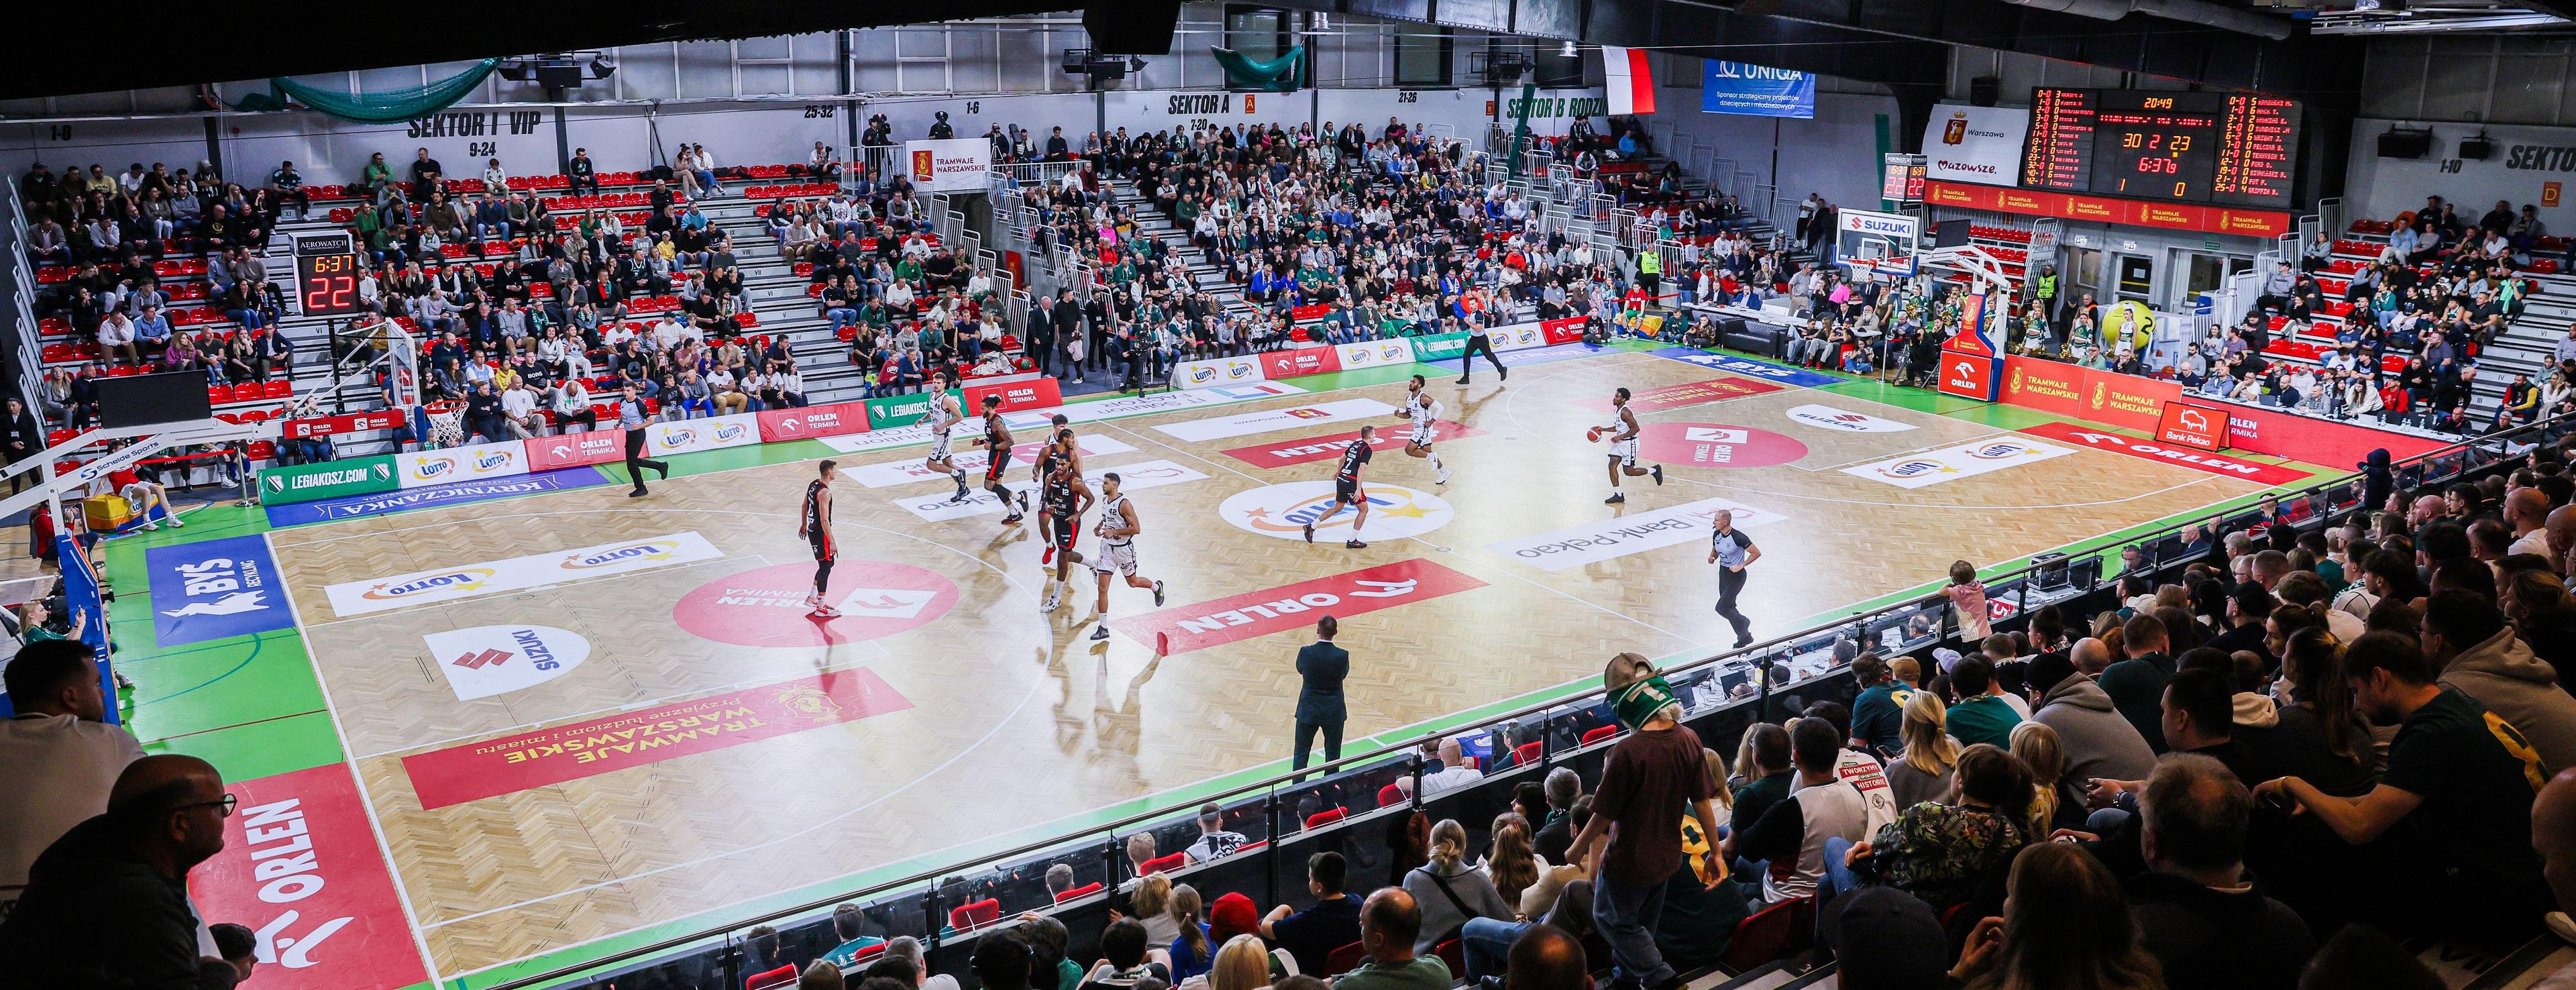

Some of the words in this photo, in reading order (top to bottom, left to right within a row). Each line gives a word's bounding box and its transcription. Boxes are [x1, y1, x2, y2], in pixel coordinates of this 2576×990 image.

[1745, 64, 1803, 80] UNIQA
[1168, 95, 1218, 114] SEKTOR
[1221, 95, 1229, 113] A
[1246, 99, 1254, 109] A
[1399, 92, 1417, 103] 21-26
[2144, 98, 2172, 108] 20:49
[804, 105, 833, 118] 25-32
[967, 101, 979, 114] 1-6
[1507, 98, 1552, 118] SETOR
[1556, 98, 1564, 117] B
[408, 112, 477, 138] SEKTOR
[491, 112, 498, 135] I
[510, 111, 541, 134] VIP
[1191, 119, 1208, 131] 7-20
[1968, 129, 2004, 138] Warszawa
[2123, 133, 2142, 148] 30
[2149, 134, 2160, 149] 2
[2170, 136, 2190, 150] 23
[470, 142, 496, 156] 9-24
[2506, 145, 2576, 172] SEKTO
[936, 164, 985, 172] WARSZAWSKIE
[1891, 166, 1908, 175] 6:37
[1913, 167, 1926, 176] 6:37
[2440, 159, 2463, 173] 1-10
[1886, 176, 1907, 195] 22
[1908, 178, 1925, 195] 22
[2121, 178, 2125, 191] 1
[2174, 182, 2186, 197] 0
[2544, 188, 2557, 201] D
[2152, 215, 2187, 223] WARSZAWSKIE
[1864, 220, 1911, 233] SUZUKI
[301, 240, 347, 248] AEROWATCH
[315, 256, 352, 272] 6:37
[309, 276, 353, 308] 22
[1492, 336, 1505, 345] LOTTO
[1520, 332, 1534, 343] LOTTO
[1428, 339, 1465, 352] LEGIAKOSZ.COM
[1295, 355, 1317, 363] ORLEN
[1352, 352, 1366, 361] LOTTO
[1384, 349, 1399, 358] LOTTO
[1232, 366, 1248, 376] LOTTO
[1297, 361, 1320, 369] TERMIKA
[527, 371, 543, 379] BORG
[1195, 370, 1212, 380] LOTTO
[1951, 379, 1976, 390] ORLEN
[2028, 376, 2068, 390] TRAMWAJE
[1008, 388, 1033, 396] ORLEN
[1010, 395, 1036, 403] TERMIKA
[2027, 384, 2079, 400] WARSZAWSKIE
[2111, 392, 2155, 406] TRAMWAJE
[1097, 402, 1181, 414] Solution
[2110, 400, 2163, 417] WARSZAWSKI
[807, 413, 837, 422] ORLEN
[808, 420, 840, 429] TERMIKA
[1796, 413, 1868, 430] SUZUKI
[2229, 417, 2257, 429] RLEN
[667, 432, 690, 445] LOTTO
[718, 426, 739, 439] LOTTO
[2166, 431, 2185, 441] Bank
[2187, 434, 2210, 446] Pekao
[2231, 428, 2258, 439] RMIKA
[580, 438, 612, 448] ORLEN
[97, 451, 130, 472] Schelde
[130, 439, 159, 456] Sports
[581, 446, 616, 456] TERMIKA
[1693, 444, 1711, 462] TERMIKA
[1713, 445, 1733, 463] ORLEN
[1983, 445, 2025, 457] LOTTO
[478, 452, 505, 468] LOTTO
[1345, 457, 1353, 469] 7
[2130, 445, 2261, 474] ORLEN
[421, 460, 447, 476] LOTTO
[1895, 461, 1939, 476] LOTTO
[291, 467, 368, 489] LEGIAKOSZ.COM
[342, 481, 541, 514] KRYNICZANKA
[1620, 518, 1695, 539] Bank
[1516, 534, 1621, 558] Pekao
[585, 545, 661, 565] LOTTO
[174, 558, 239, 596] BYŚ
[240, 560, 262, 588] RECYKLING
[390, 573, 473, 595] LOTTO
[726, 588, 810, 598] ERMIKA
[1176, 593, 1340, 634] ORLEN
[512, 629, 560, 671] SUZUKI
[649, 697, 741, 720] Przyjazne
[565, 716, 644, 737] ludziom
[504, 706, 756, 765] WARSZAWSKIE
[576, 716, 768, 765] TRAMWAJE
[476, 736, 549, 755] miastu
[1843, 765, 1878, 775] TWORZYMY
[1857, 779, 1886, 789] HISTORIE
[241, 798, 325, 903] ORLEN
